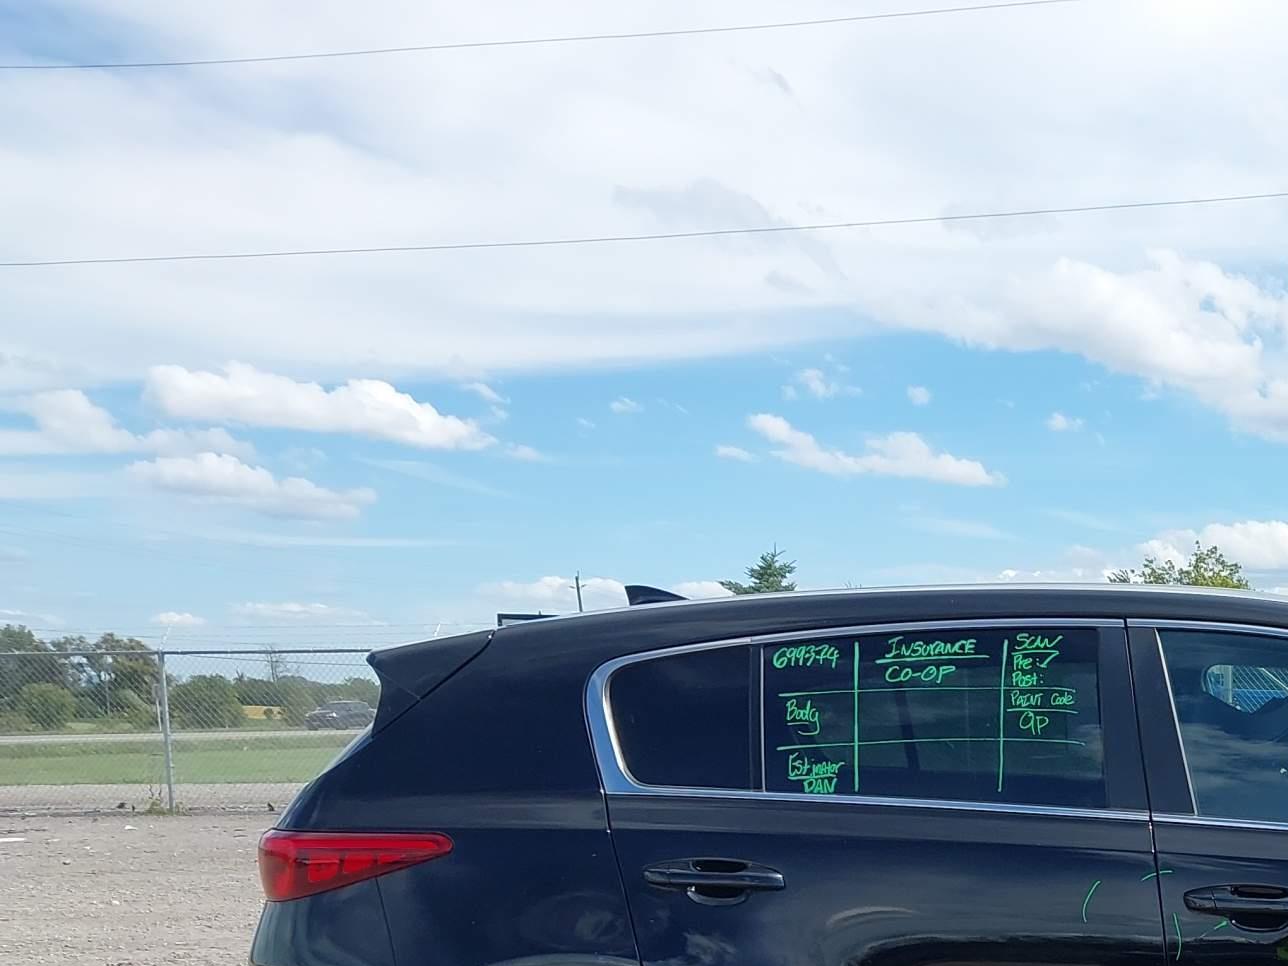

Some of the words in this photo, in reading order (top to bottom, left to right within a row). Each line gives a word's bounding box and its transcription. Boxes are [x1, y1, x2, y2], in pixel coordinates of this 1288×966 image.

[773, 644, 839, 668] 699374
[1050, 691, 1075, 706] Code
[786, 699, 819, 735] Body
[803, 778, 837, 793] DAN
